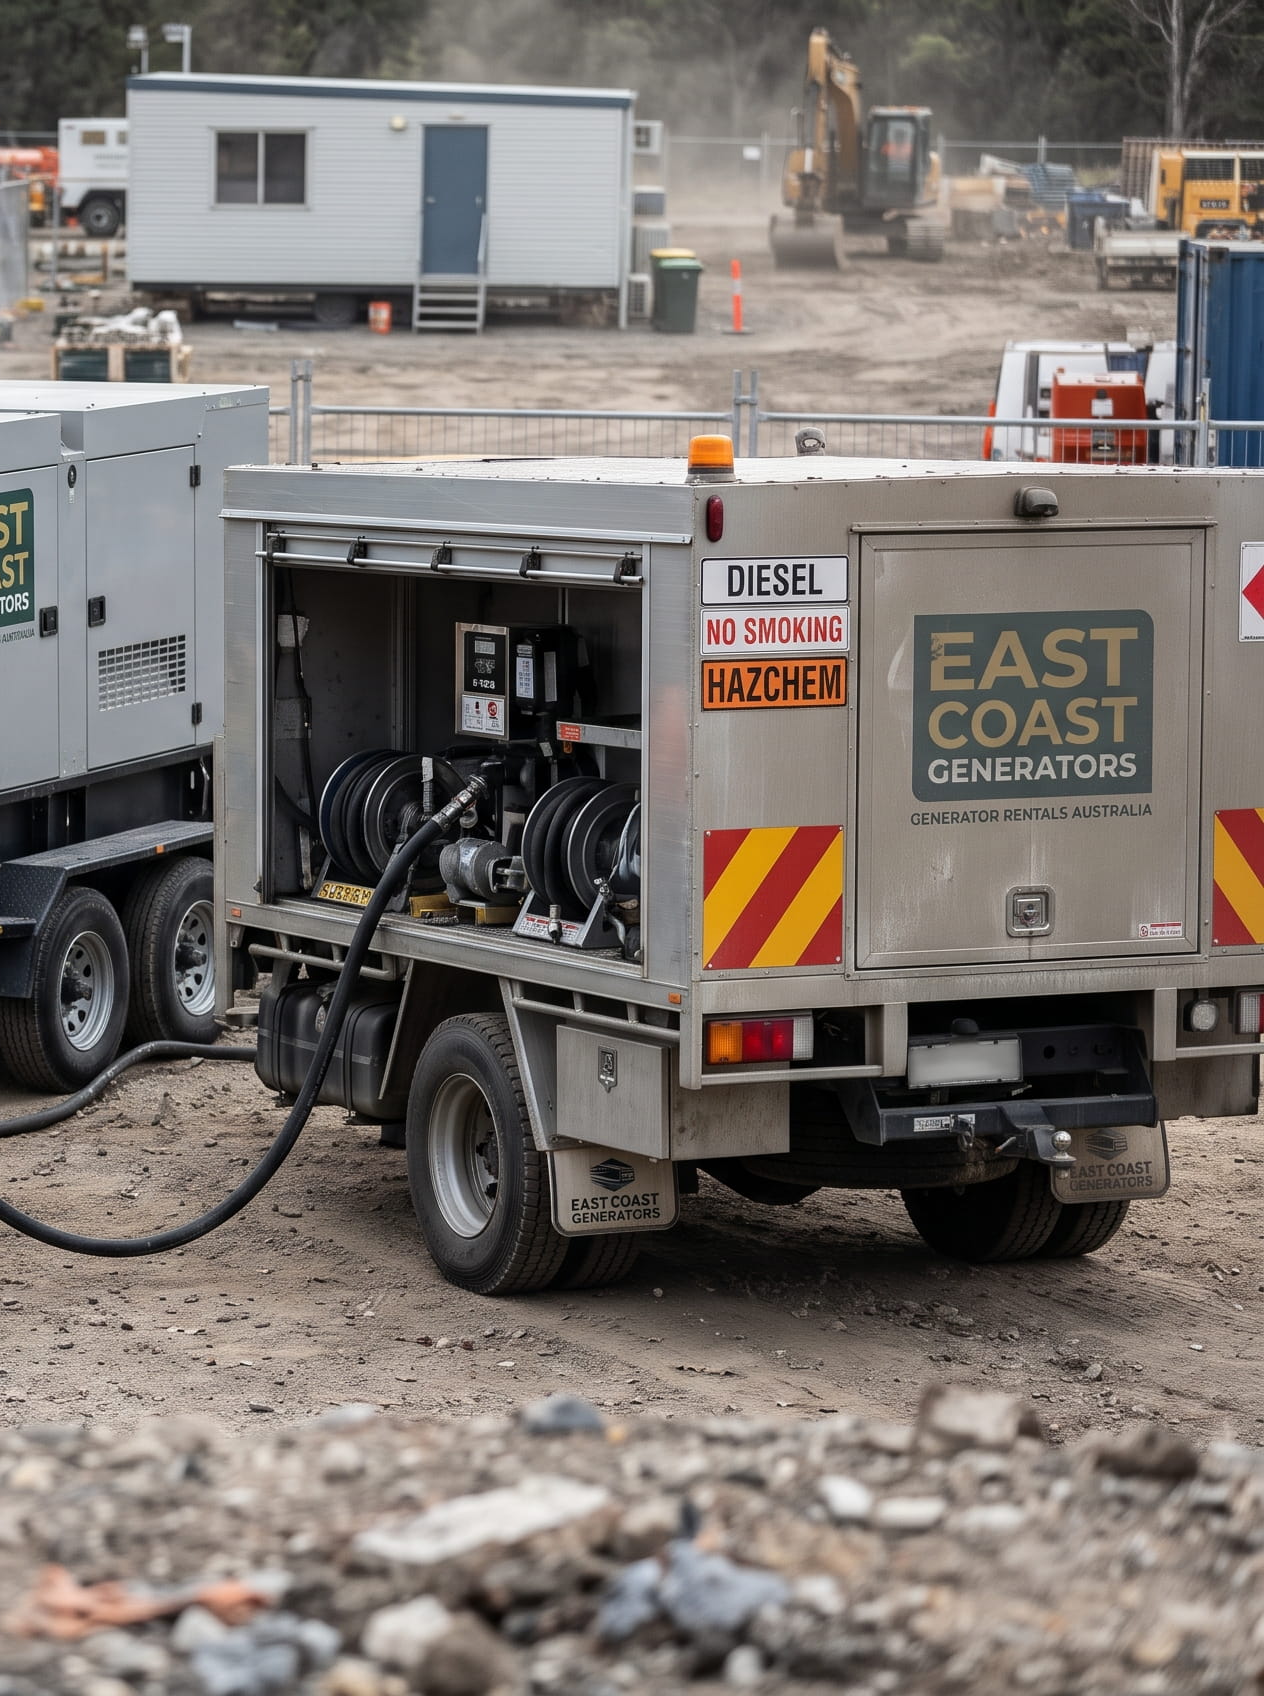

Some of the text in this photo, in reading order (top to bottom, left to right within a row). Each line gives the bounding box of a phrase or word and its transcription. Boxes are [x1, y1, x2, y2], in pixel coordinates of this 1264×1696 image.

[727, 563, 823, 597] DIESEL
[707, 615, 842, 646] NO SMOKING
[930, 627, 1139, 691] EAST
[708, 664, 841, 703] HAZCHEM
[928, 696, 1138, 750] COAST
[927, 752, 1137, 784] GENERATORS
[910, 803, 1153, 826] GENERATOR RENTALS AUSTRALIA
[1070, 1161, 1152, 1179] EAST COAST
[1070, 1175, 1153, 1192] GENERATORS
[571, 1192, 659, 1211] EAST COAST
[571, 1207, 661, 1224] GENERATORS
